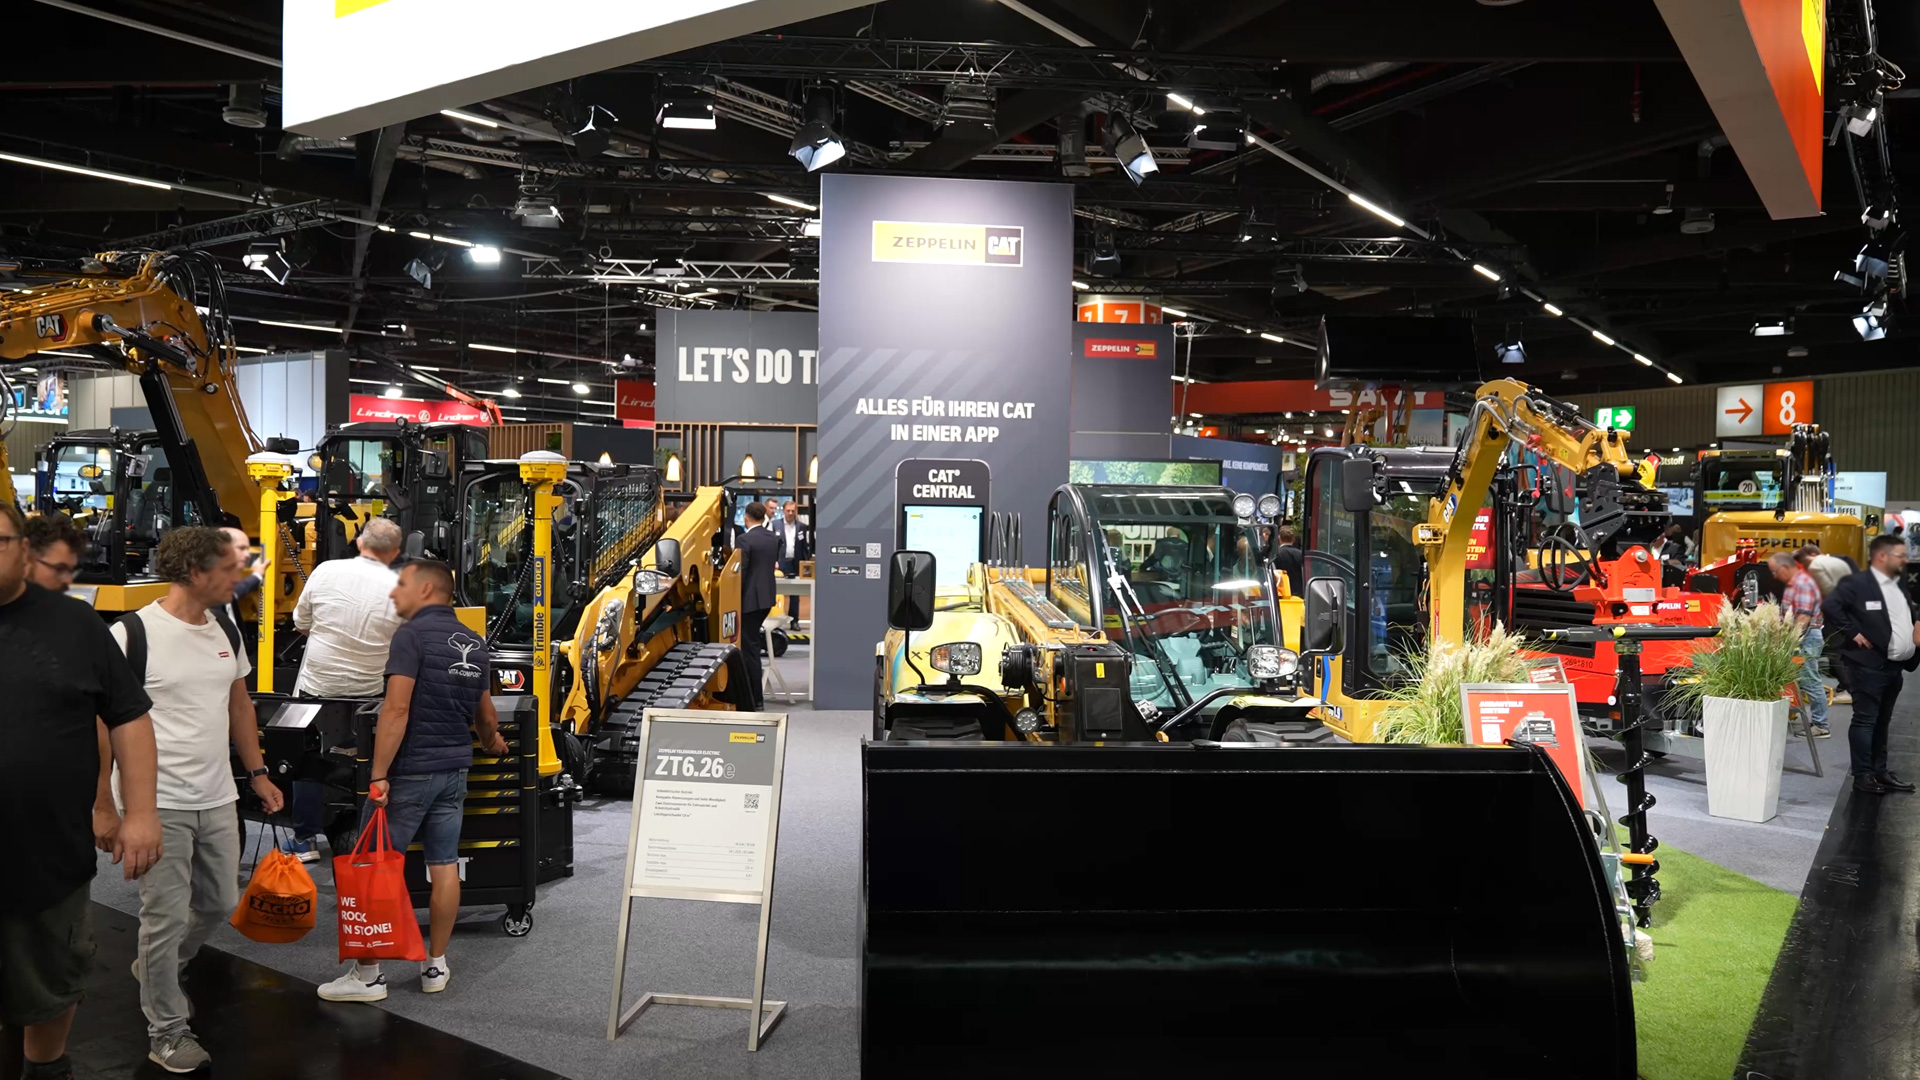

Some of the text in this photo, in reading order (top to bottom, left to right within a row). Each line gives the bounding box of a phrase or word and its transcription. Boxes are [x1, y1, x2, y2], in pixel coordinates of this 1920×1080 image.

[892, 235, 1021, 256] ZEPPELIN CAT
[1114, 309, 1129, 324] 7
[35, 314, 61, 338] CAT
[1091, 344, 1130, 353] ZEPPELIN
[678, 346, 819, 385] LET'S DO T
[356, 407, 416, 420] Lindner
[855, 396, 1036, 419] ALLES FÜR IHREN CAT
[1779, 390, 1796, 426] 8
[438, 412, 479, 421] Lindner
[890, 424, 1000, 443] IN EINER APP
[426, 486, 439, 494] CAT
[913, 484, 976, 499] CENTRAL
[1742, 482, 1753, 493] 20
[534, 611, 545, 653] Trimble
[722, 611, 737, 639] CAT
[654, 755, 736, 779] ZT6.26e
[340, 896, 356, 908] WE
[341, 910, 367, 923] ROCK
[342, 922, 393, 936] IN STONE!
